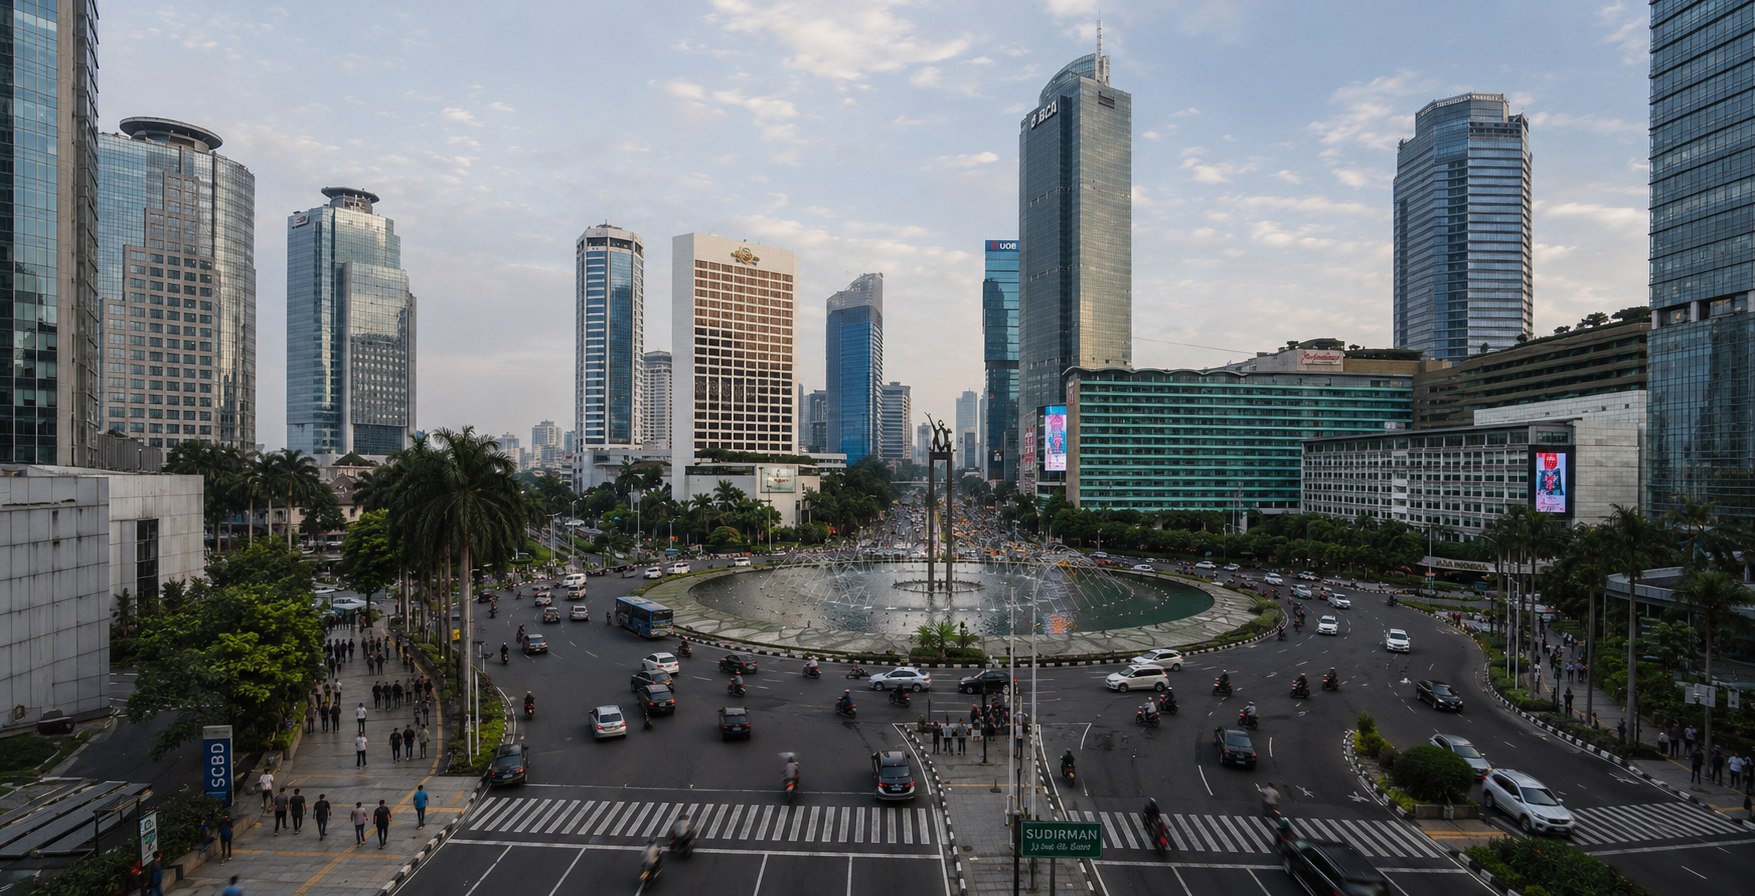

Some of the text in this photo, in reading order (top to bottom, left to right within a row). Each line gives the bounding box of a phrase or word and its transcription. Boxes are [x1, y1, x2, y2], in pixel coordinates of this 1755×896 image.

[1037, 100, 1058, 125] BCA
[999, 242, 1017, 250] UOB
[210, 742, 226, 788] SCBD
[1026, 828, 1098, 841] SUDIRMAN
